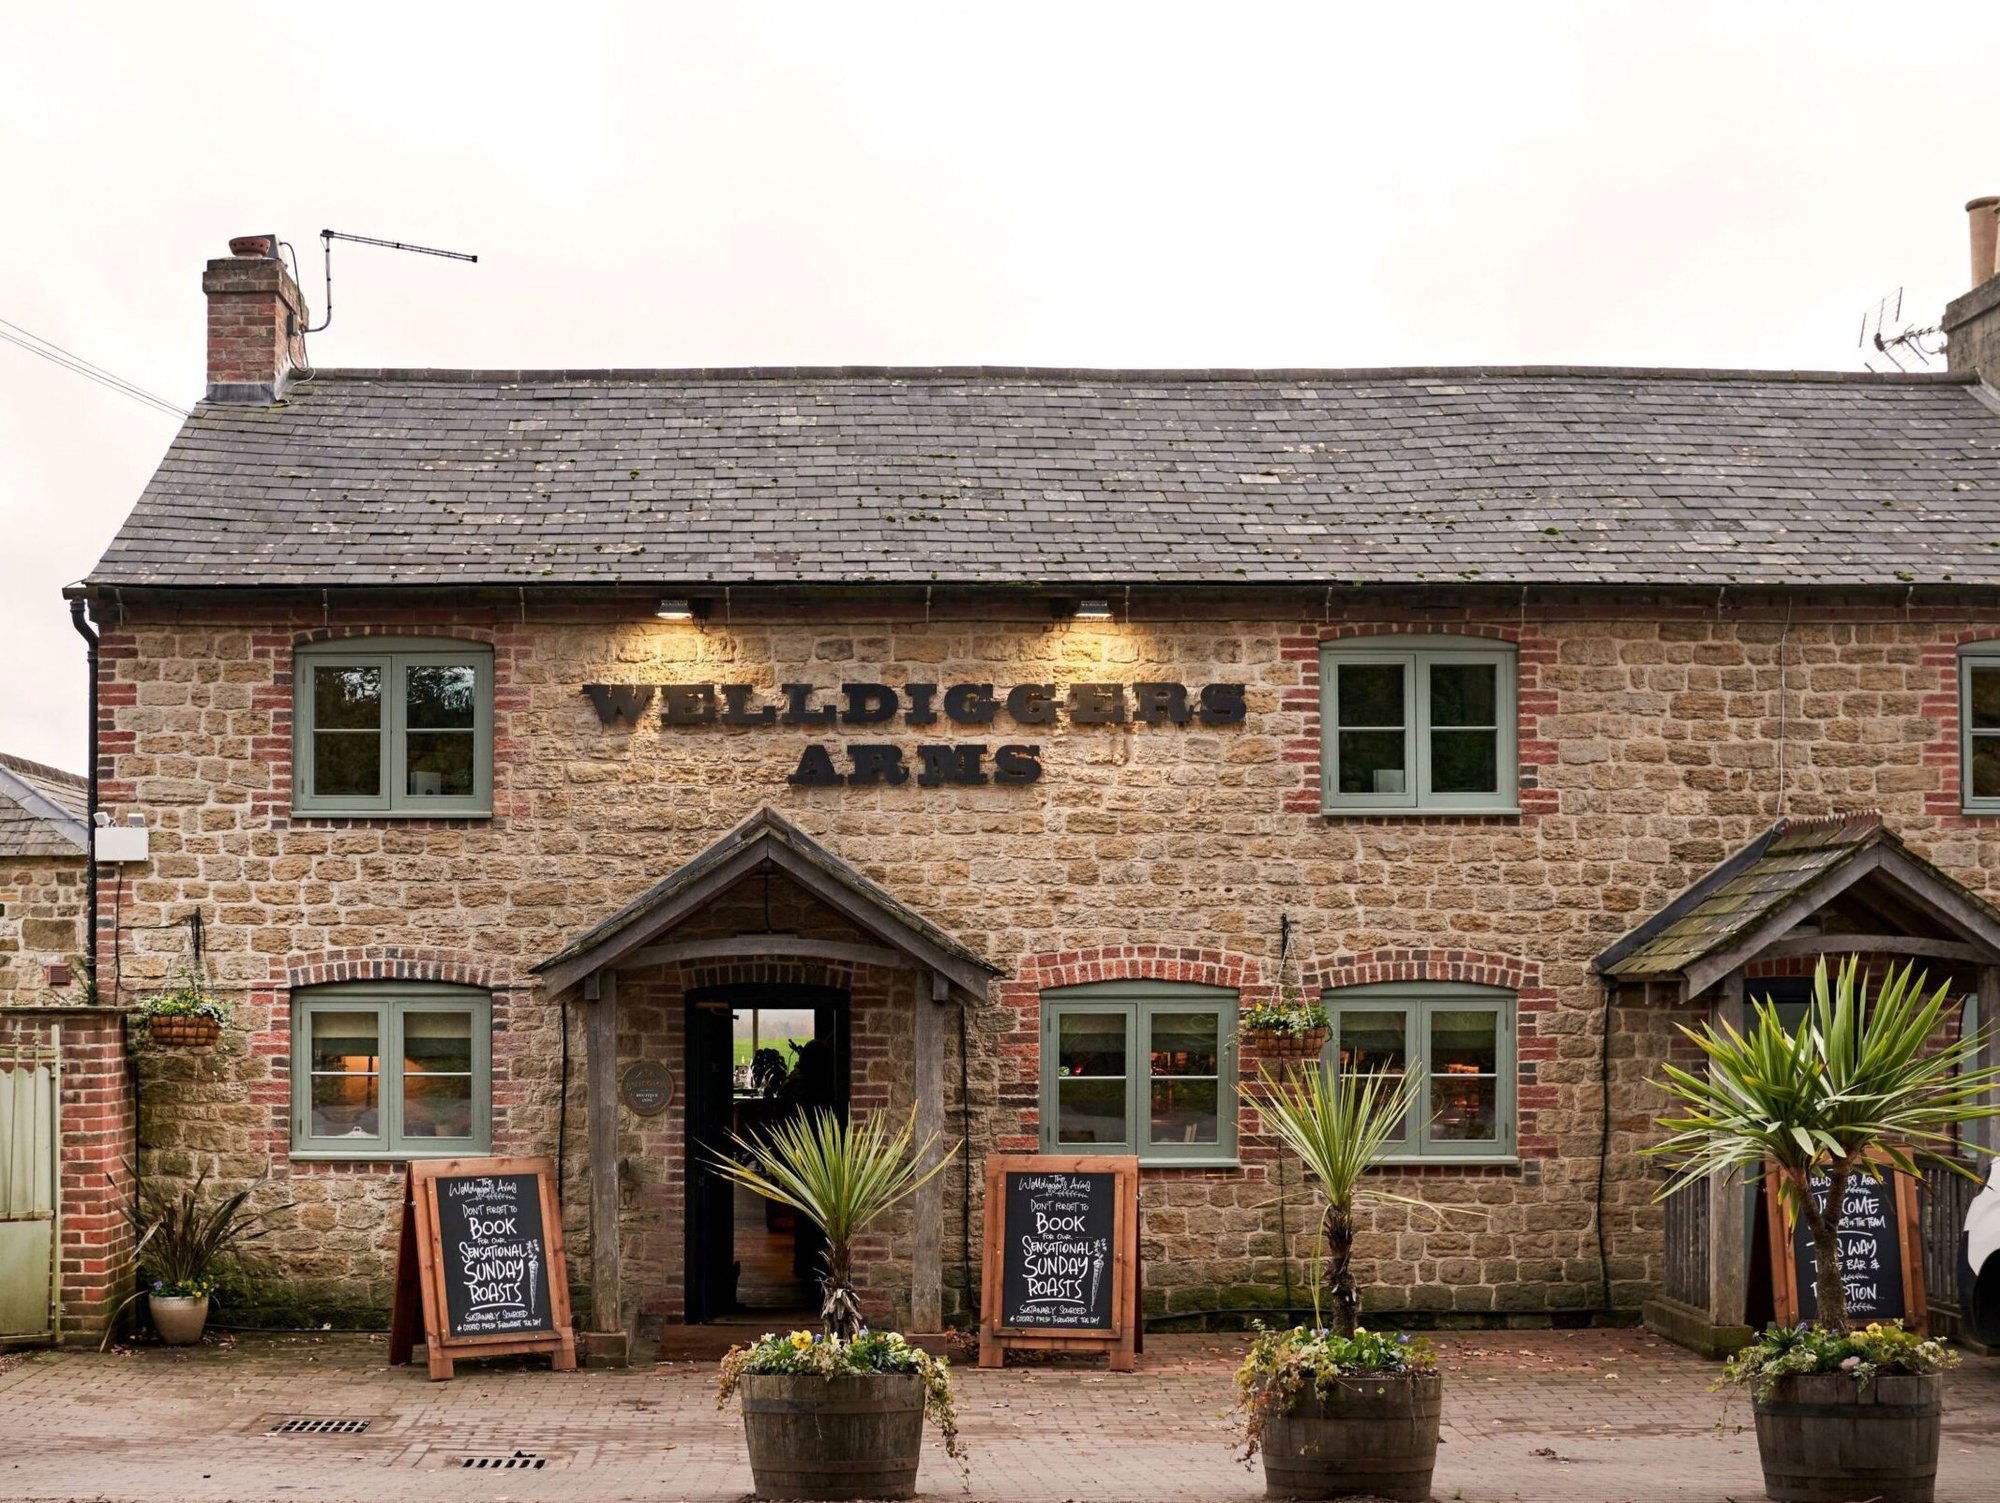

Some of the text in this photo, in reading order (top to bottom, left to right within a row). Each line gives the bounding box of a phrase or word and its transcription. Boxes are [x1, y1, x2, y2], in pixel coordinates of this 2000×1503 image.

[582, 683, 1246, 725] WELLDIGGERS
[787, 744, 1042, 785] ARMS
[497, 1179, 517, 1194] Arms
[1070, 1177, 1091, 1192] Arms
[462, 1204, 518, 1218] DON'T FORGET TO
[1030, 1199, 1089, 1212] DON'T FORGET TO
[469, 1217, 517, 1240] BOOK
[1036, 1212, 1086, 1234] BOOK
[1865, 1215, 1886, 1228] TEAM
[459, 1241, 528, 1263] SENSATIONAL
[477, 1238, 490, 1246] FOR
[1022, 1235, 1094, 1256] SENSATIONAL
[1847, 1239, 1877, 1258] WAY
[463, 1259, 524, 1285] SUNDAY
[1022, 1255, 1088, 1278] SUNDAY
[1846, 1258, 1867, 1271] BAR
[1870, 1258, 1881, 1271] &
[468, 1282, 522, 1304] ROASTS
[1027, 1277, 1082, 1299] ROASTS
[502, 1309, 528, 1319] SOURCED
[1059, 1305, 1087, 1315] SOURCED
